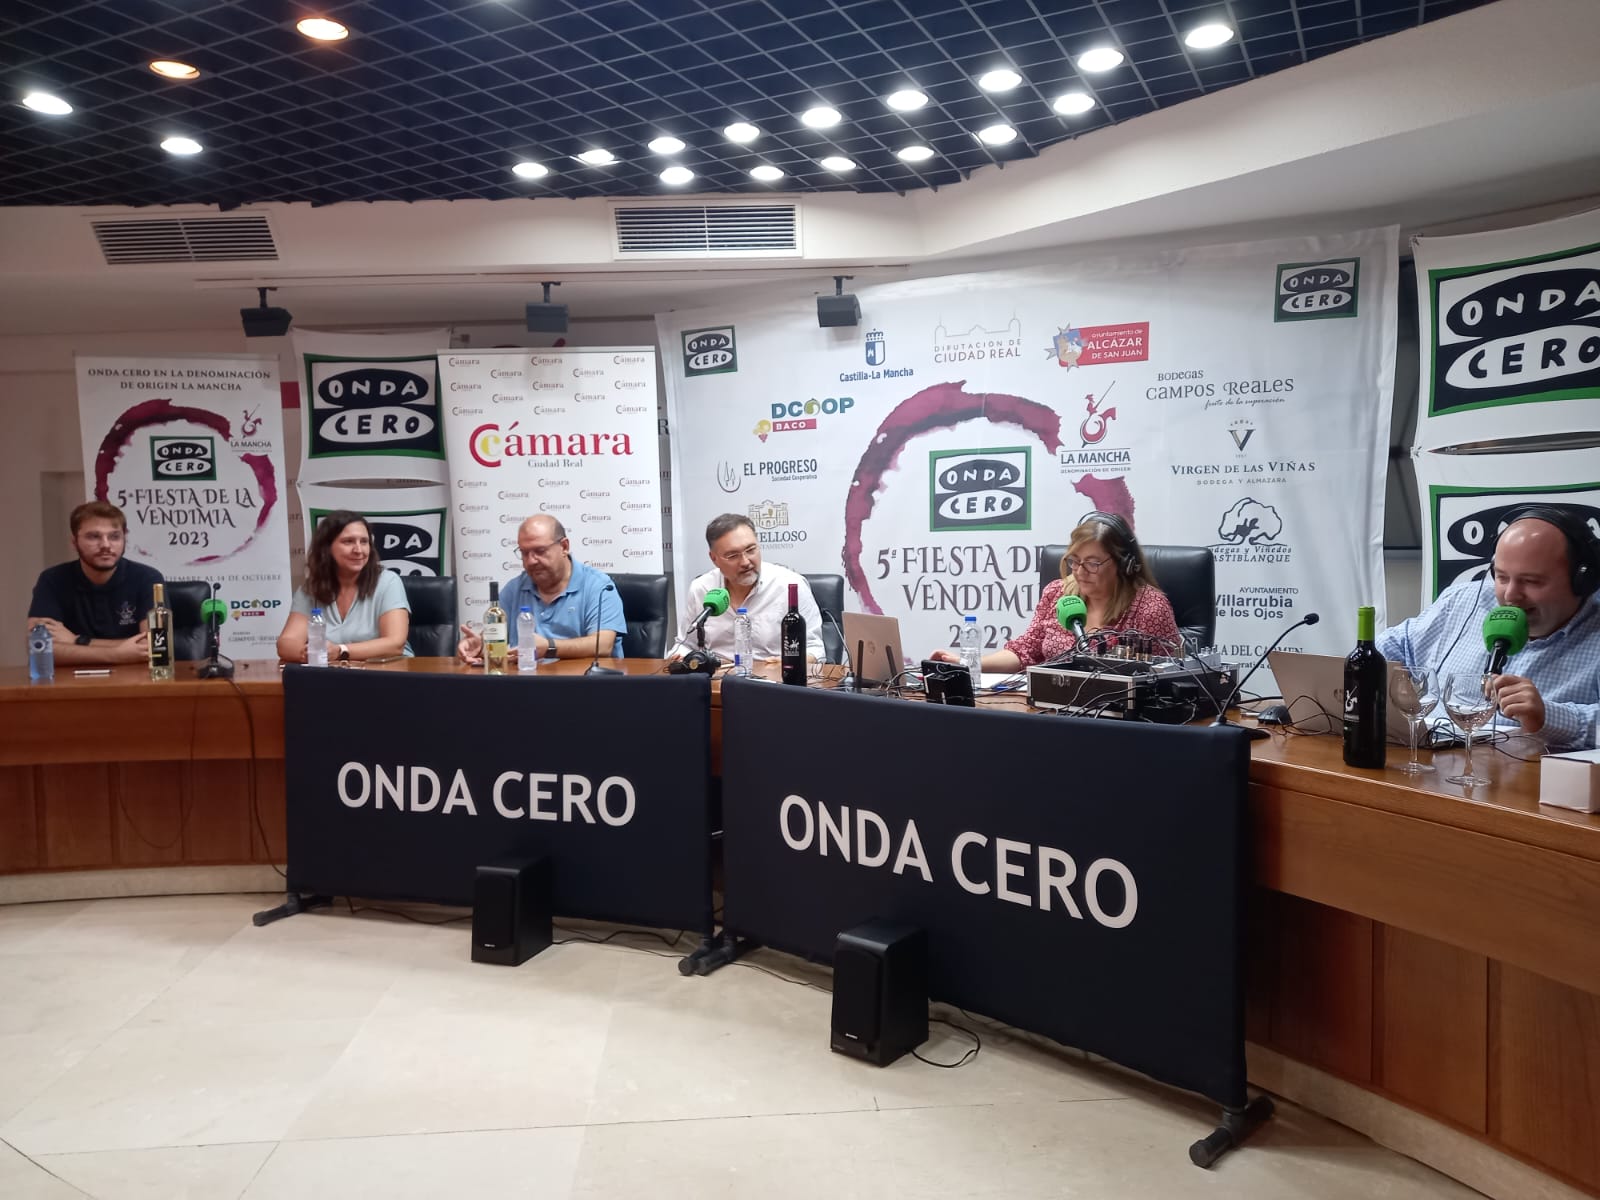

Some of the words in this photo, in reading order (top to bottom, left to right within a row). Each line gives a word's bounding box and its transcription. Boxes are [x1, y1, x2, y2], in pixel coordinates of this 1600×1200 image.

[1290, 273, 1343, 288] ONDA
[1292, 294, 1343, 308] CERO
[1462, 281, 1600, 325] ONDA
[691, 337, 727, 350] ONDA
[694, 353, 727, 366] CERO
[935, 350, 985, 363] CIUDAD
[991, 347, 1021, 359] REAL
[1469, 336, 1600, 378] CERO
[88, 369, 120, 377] ONDA
[122, 369, 150, 377] CERO
[171, 370, 183, 378] LA
[883, 367, 914, 379] Mancha
[120, 382, 134, 390] DE
[137, 382, 178, 390] ORIGEN
[197, 383, 242, 391] MANCHA
[328, 380, 418, 398] ONDA
[335, 415, 419, 435] CERO
[776, 421, 807, 431] BACO
[161, 447, 204, 455] ONDA
[469, 421, 634, 467] Cámara
[528, 459, 559, 468] Ciudad
[563, 459, 583, 468] Real
[1061, 454, 1075, 464] LA
[1078, 451, 1130, 463] MANCHA
[165, 462, 204, 471] CERO
[744, 463, 756, 476] EL
[760, 459, 817, 475] PROGRESO
[1172, 465, 1220, 475] VIRGEN
[1224, 465, 1239, 473] DE
[1244, 465, 1263, 473] LAS
[1268, 461, 1315, 472] VIÑAS
[947, 468, 1012, 484] ONDA
[135, 488, 201, 507] FIESTA
[201, 489, 227, 505] DE
[235, 488, 256, 507] LA
[950, 496, 1013, 514] CERO
[137, 508, 236, 528] VENDIMIA
[169, 532, 209, 547] 2023
[372, 533, 422, 549] DA
[756, 531, 807, 542] ELLOSO
[902, 544, 1007, 580] FIESTA
[1214, 555, 1291, 563] STIBLANQUE
[902, 576, 1040, 618] VENDIMI
[1231, 608, 1249, 617] los
[1254, 608, 1283, 620] Ojos
[950, 625, 1012, 648] 223
[1231, 644, 1252, 656] DEL
[338, 762, 478, 815] ONDA
[493, 771, 636, 826] CERO
[780, 795, 933, 882] ONDA
[952, 831, 1138, 928] CERO
